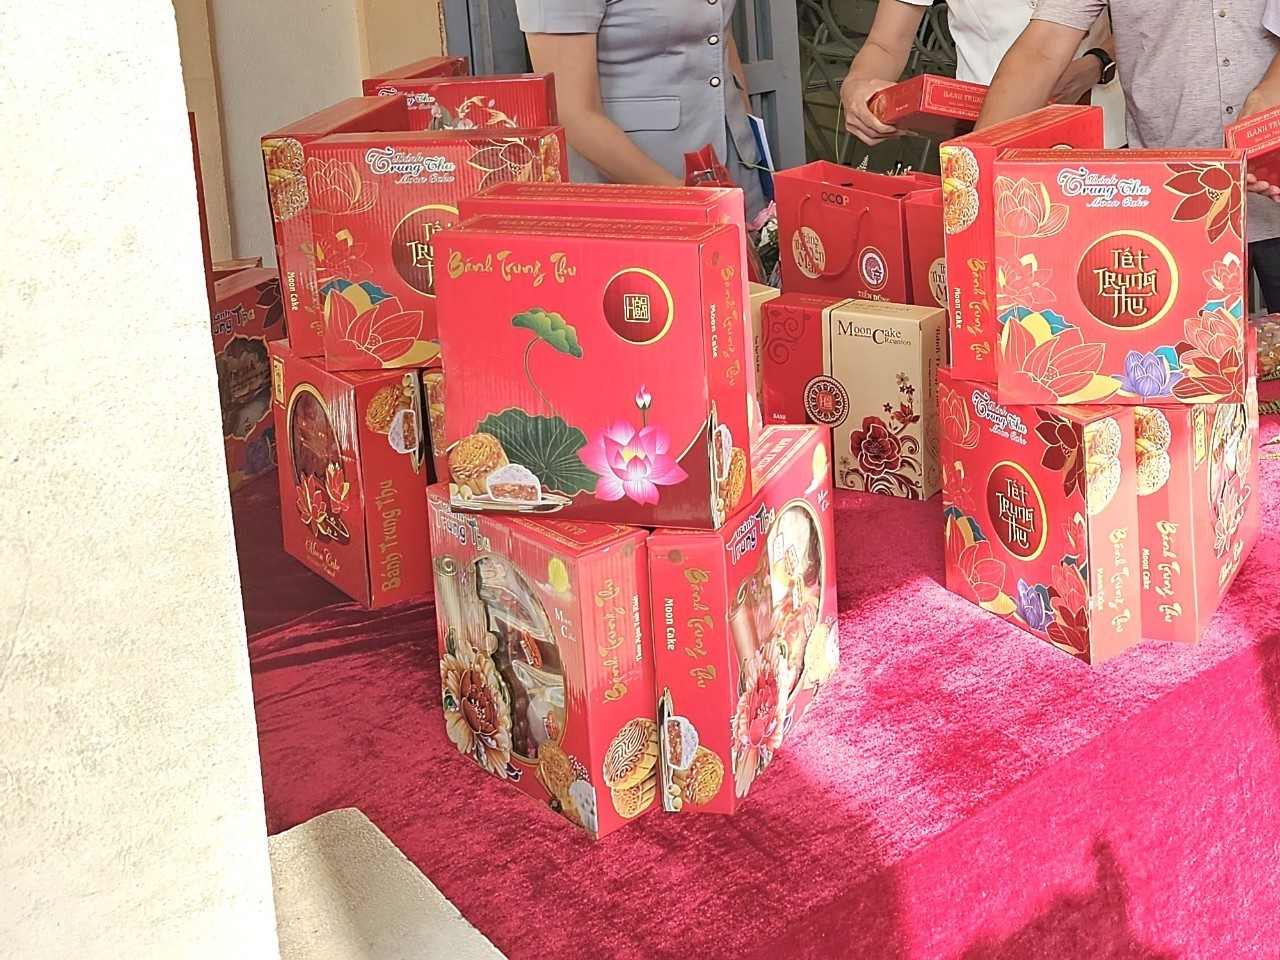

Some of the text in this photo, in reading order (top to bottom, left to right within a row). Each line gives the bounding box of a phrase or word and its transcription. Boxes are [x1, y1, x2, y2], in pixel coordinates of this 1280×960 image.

[365, 146, 456, 176] Trung Thu
[821, 191, 850, 206] OCOP
[1057, 166, 1152, 200] Trung Thu
[447, 247, 493, 279] Bánh
[497, 250, 547, 287] Trung
[550, 252, 577, 283] Thu
[1110, 247, 1150, 272] Tết
[287, 271, 299, 311] Moon Cake
[954, 287, 964, 329] Moon Cake
[966, 257, 990, 362] Bánh Trung Thu
[838, 320, 902, 345] Moon Cake
[884, 337, 911, 346] Reunion
[972, 390, 1027, 435] Trung Thu
[1005, 478, 1028, 506] Tết
[374, 479, 403, 592] Bánh Trung Thu
[1108, 526, 1131, 633] Bánh Trung Thu
[1142, 547, 1151, 590] Moon Cake
[1155, 519, 1182, 622] Bánh Trung Thu
[665, 598, 676, 651] Moon Cake
[684, 567, 716, 688] Bánh Trung Thu
[602, 656, 628, 704] Bánh
